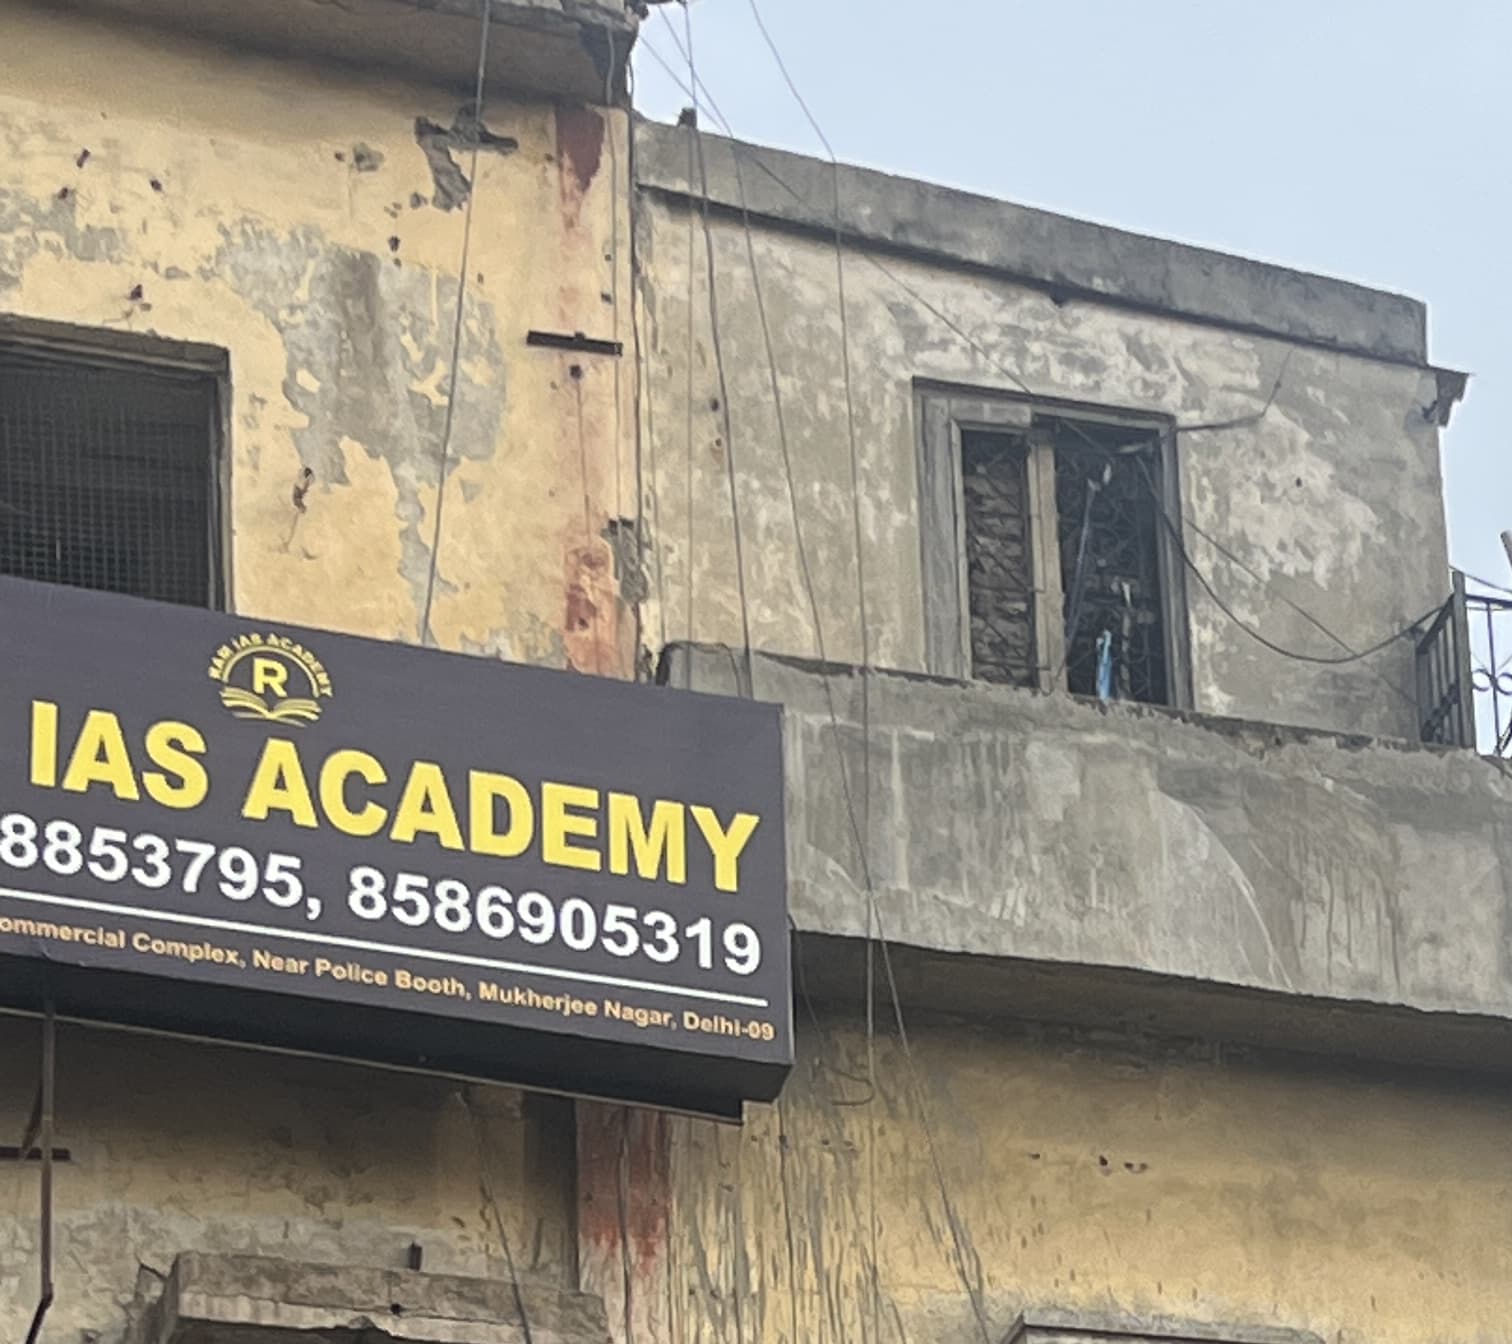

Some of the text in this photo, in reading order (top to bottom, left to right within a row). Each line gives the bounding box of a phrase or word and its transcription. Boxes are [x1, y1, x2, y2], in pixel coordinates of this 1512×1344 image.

[29, 700, 760, 892] IAS ACADEMY
[0, 812, 761, 976] 8853795, 8586905319
[132, 931, 775, 1041] Complex, Near Police Booth, Mukherjee Nagar, Delhi-09
